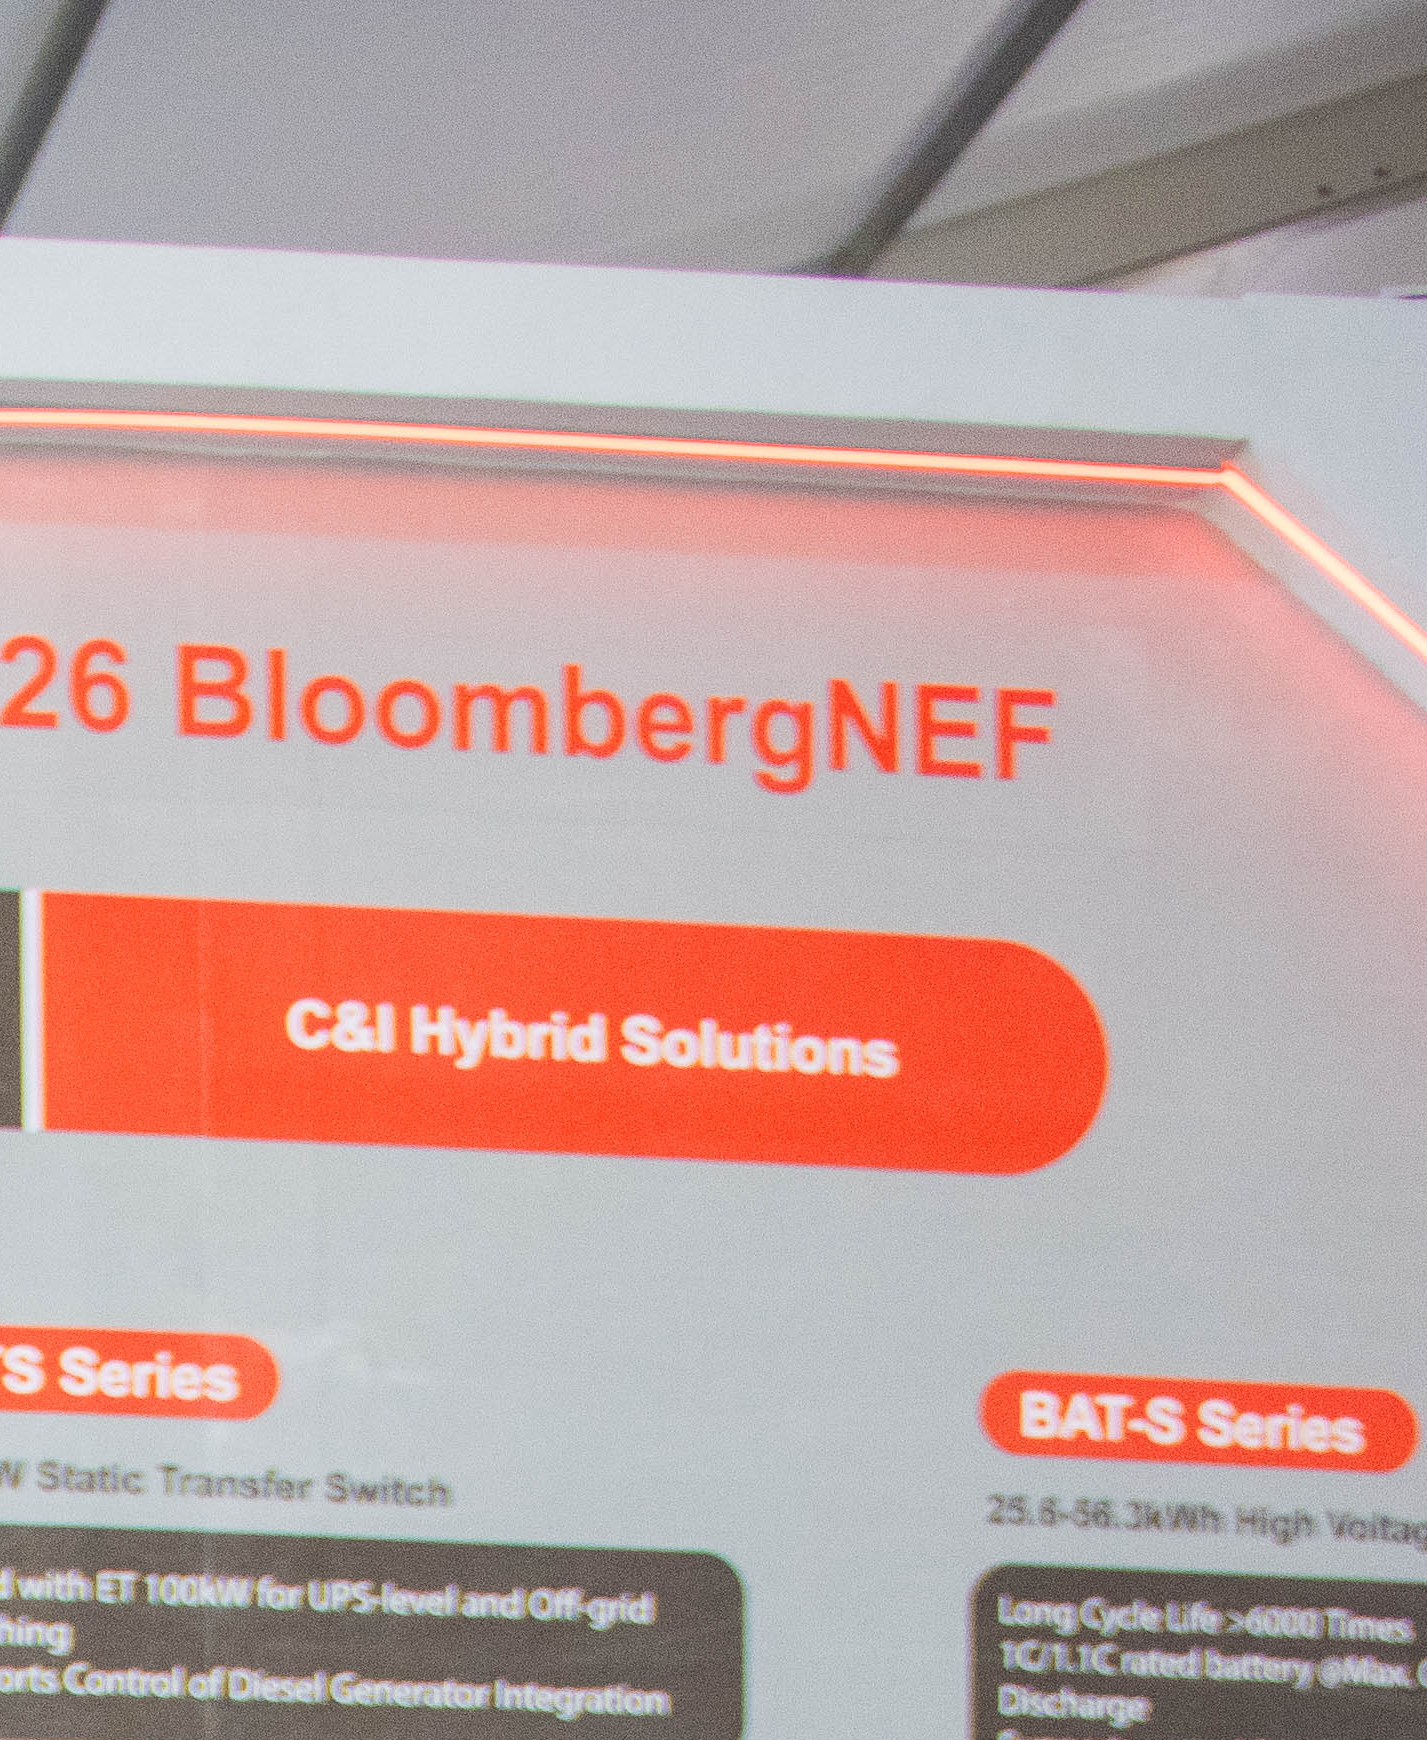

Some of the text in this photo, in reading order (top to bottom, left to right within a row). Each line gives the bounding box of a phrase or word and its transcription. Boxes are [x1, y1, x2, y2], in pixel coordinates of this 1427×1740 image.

[178, 643, 1056, 793] BloombergNEF
[287, 998, 899, 1077] C&I Hybrid Solutions
[60, 1346, 239, 1402] Series
[1022, 1390, 1365, 1453] BAT-S Series
[38, 1460, 145, 1495] Static
[158, 1463, 314, 1501] Transfer
[327, 1472, 452, 1507] Switch
[1236, 1508, 1317, 1546] High
[18, 1570, 92, 1601] with
[97, 1571, 137, 1603] ET
[146, 1574, 253, 1607] 100kW
[257, 1576, 303, 1609] for
[309, 1580, 458, 1616] UPS-level
[462, 1588, 524, 1619] and
[529, 1589, 654, 1629] Off-grid
[999, 1596, 1081, 1635] Long
[1077, 1597, 1164, 1635] Cycle
[1166, 1601, 1223, 1634] Life
[1322, 1608, 1414, 1642] Times
[64, 1663, 184, 1698] Control
[189, 1667, 225, 1699] of
[229, 1668, 326, 1703] Diesel
[331, 1672, 490, 1708] Generator
[496, 1680, 670, 1720] Integration
[1121, 1648, 1202, 1678] rated
[1205, 1649, 1316, 1689] battery
[999, 1684, 1150, 1728] Discharge
